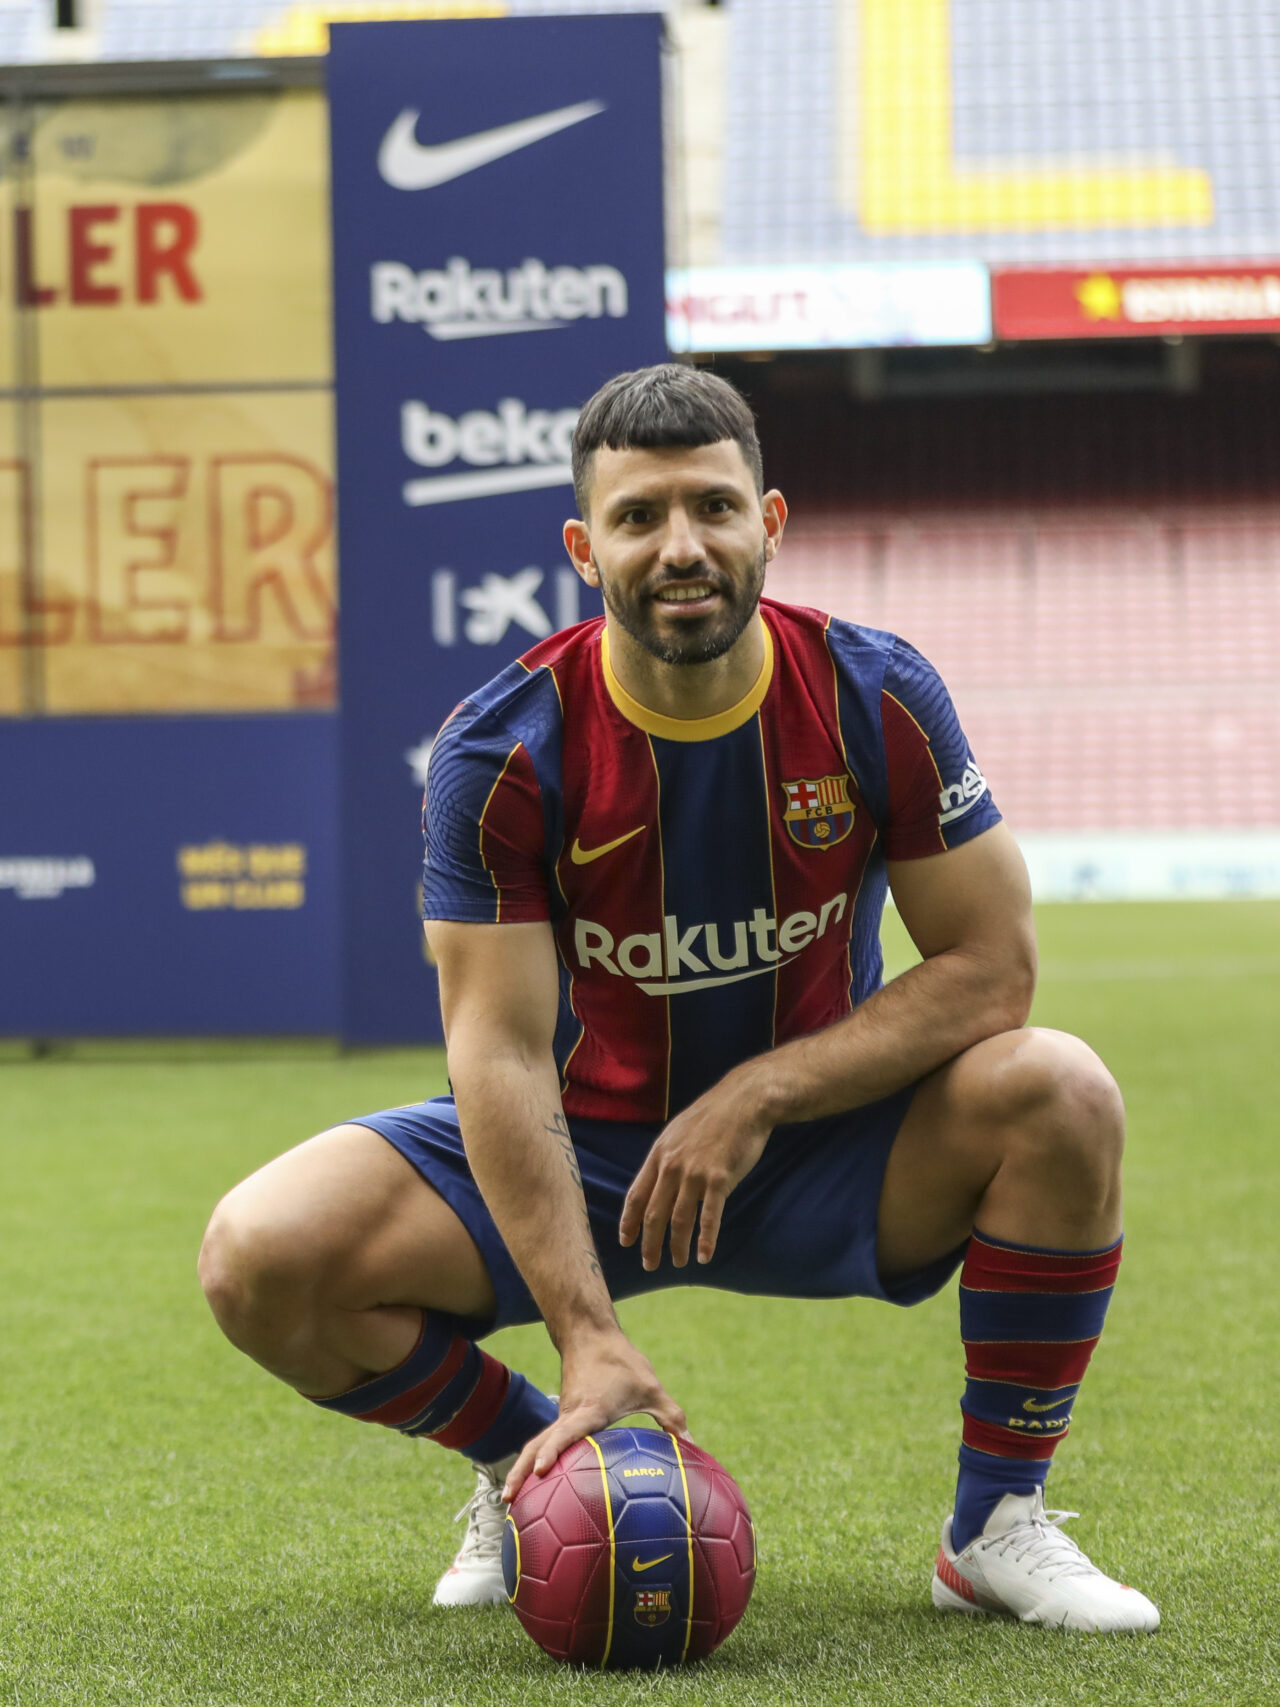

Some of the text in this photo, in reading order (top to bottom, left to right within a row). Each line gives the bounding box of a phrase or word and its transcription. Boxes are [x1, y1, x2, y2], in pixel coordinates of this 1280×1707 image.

[370, 256, 628, 324] Rakuten
[575, 893, 847, 979] Rakuten
[624, 1468, 665, 1477] BARÇA
